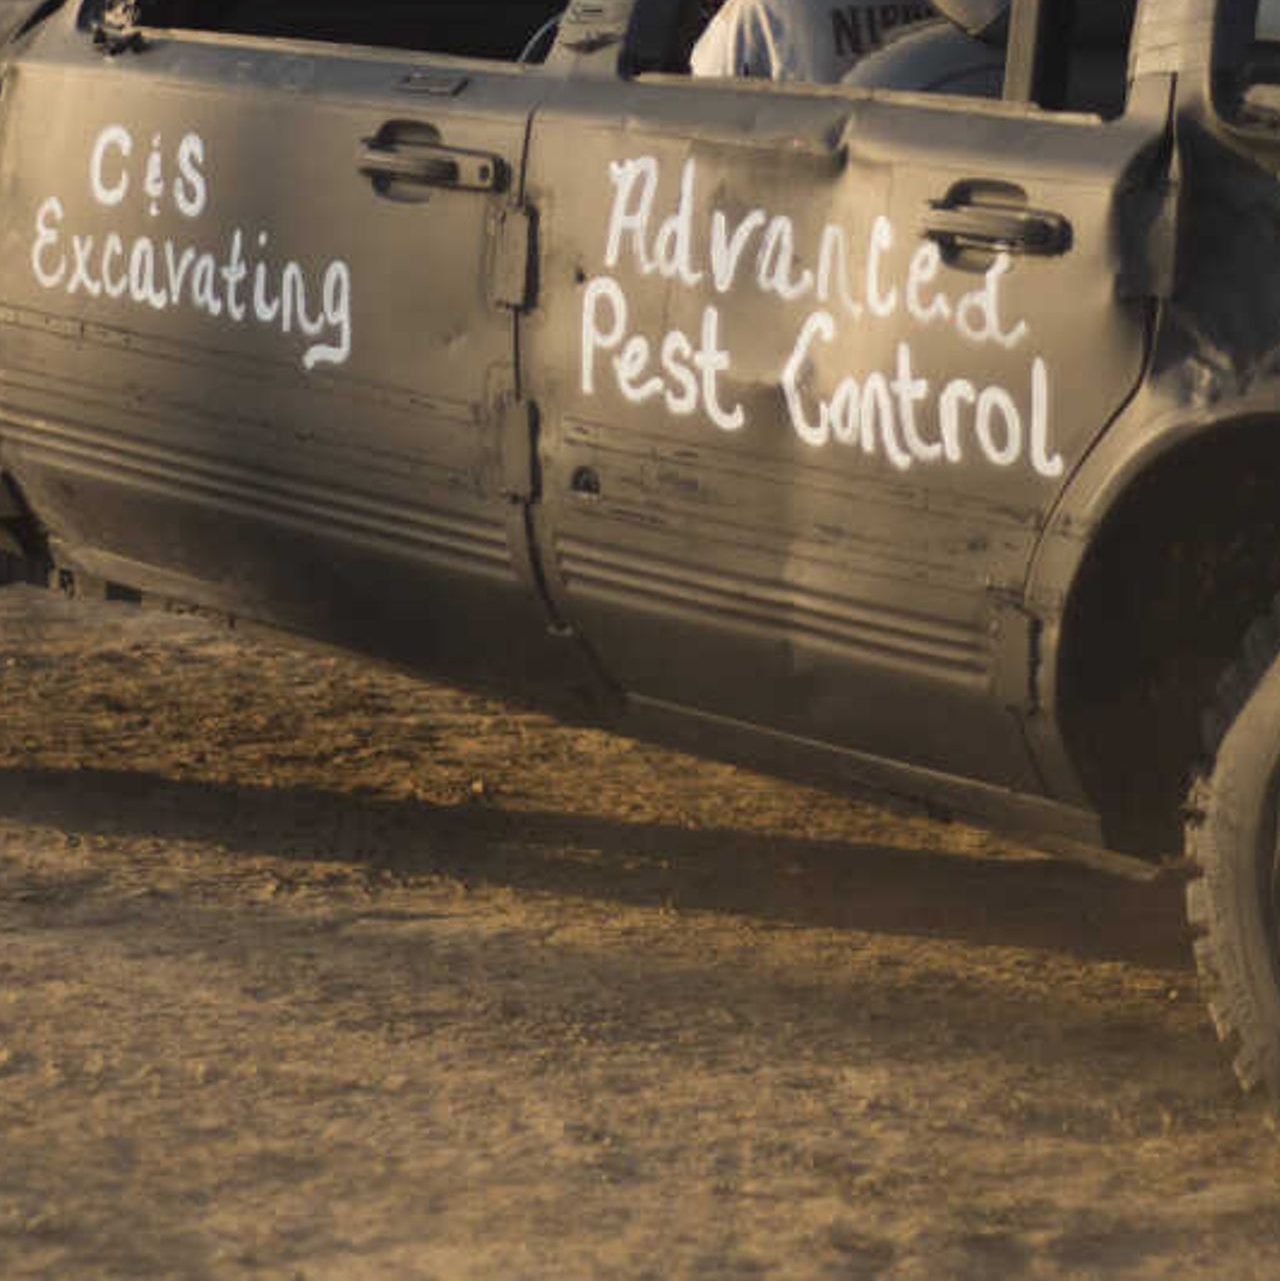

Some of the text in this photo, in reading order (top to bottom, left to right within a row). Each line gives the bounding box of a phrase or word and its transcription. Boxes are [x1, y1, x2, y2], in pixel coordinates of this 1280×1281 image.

[32, 196, 351, 369] Excavating
[605, 155, 1027, 348] Advanced
[582, 276, 1064, 477] Pest Control
